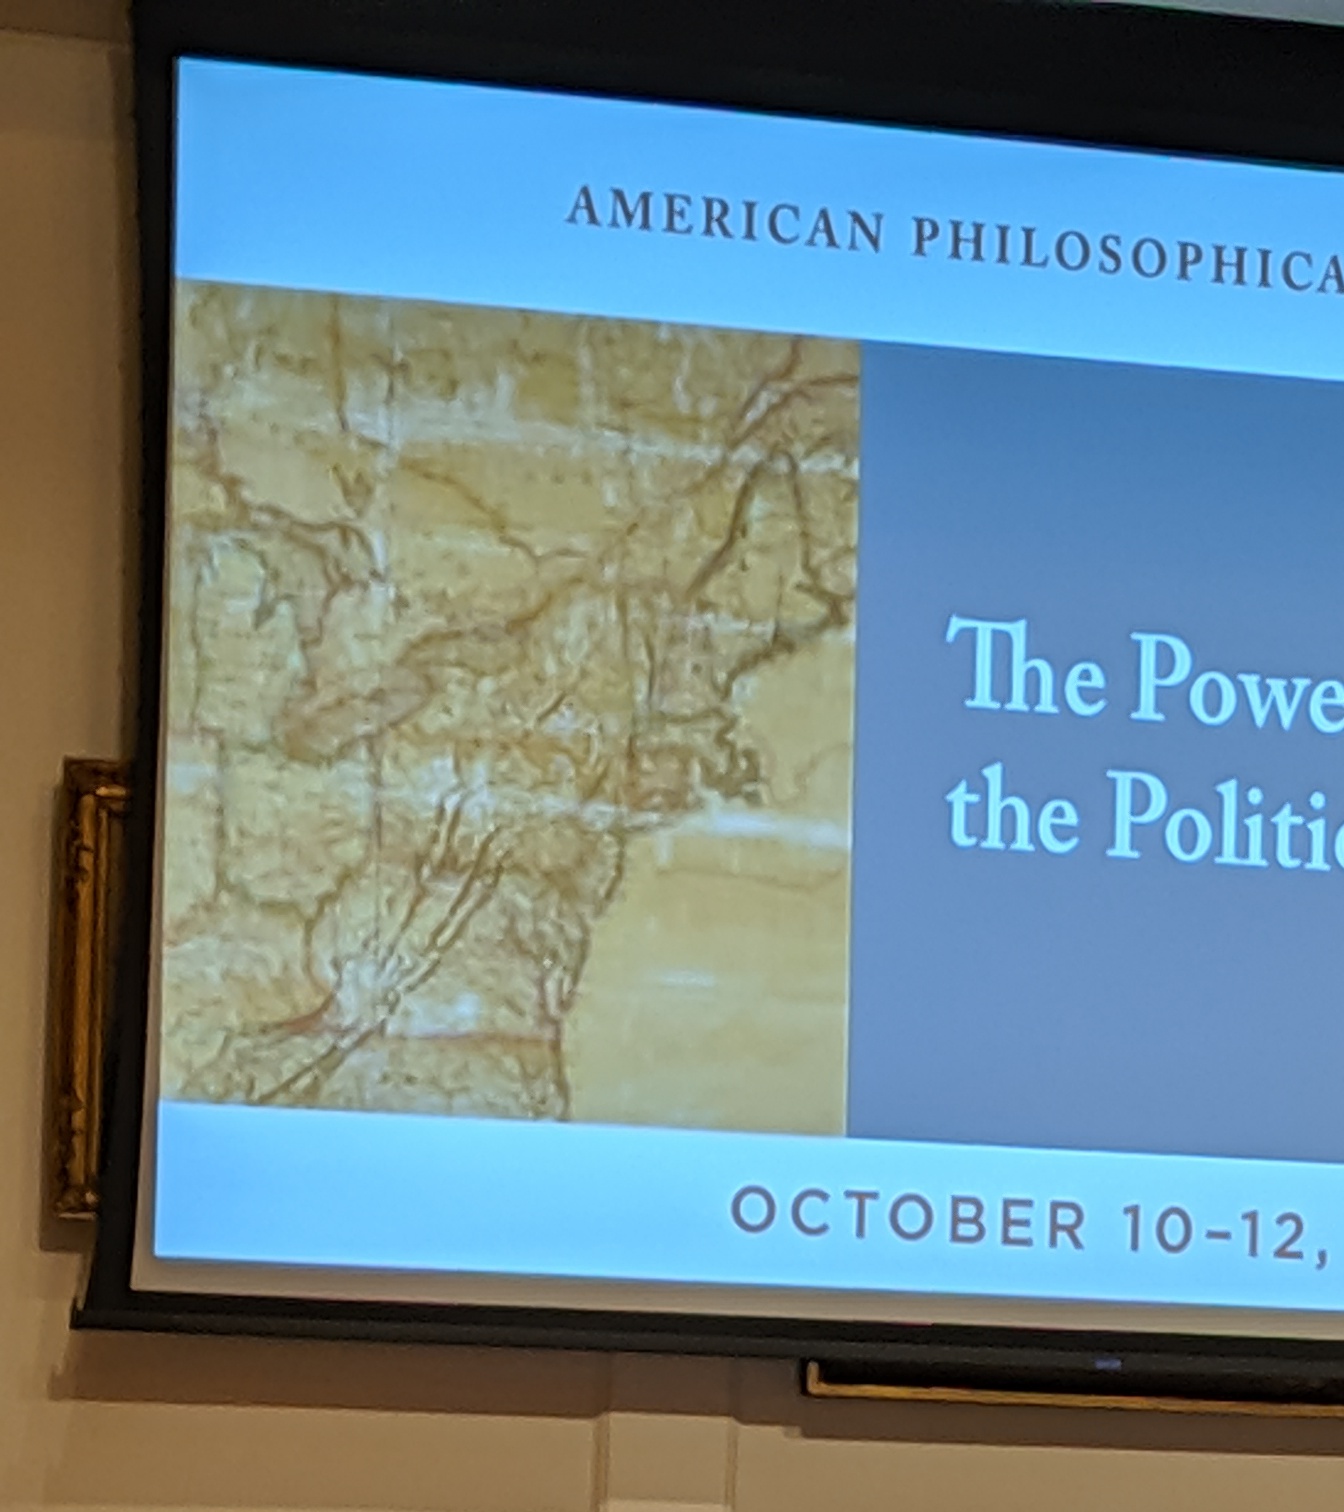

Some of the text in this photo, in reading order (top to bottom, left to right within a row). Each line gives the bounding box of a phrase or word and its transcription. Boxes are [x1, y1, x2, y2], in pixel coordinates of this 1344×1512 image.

[565, 184, 884, 254] AMERICAN
[945, 613, 1108, 717] The
[945, 761, 1080, 855] the
[729, 1184, 1086, 1252] OCTOBER
